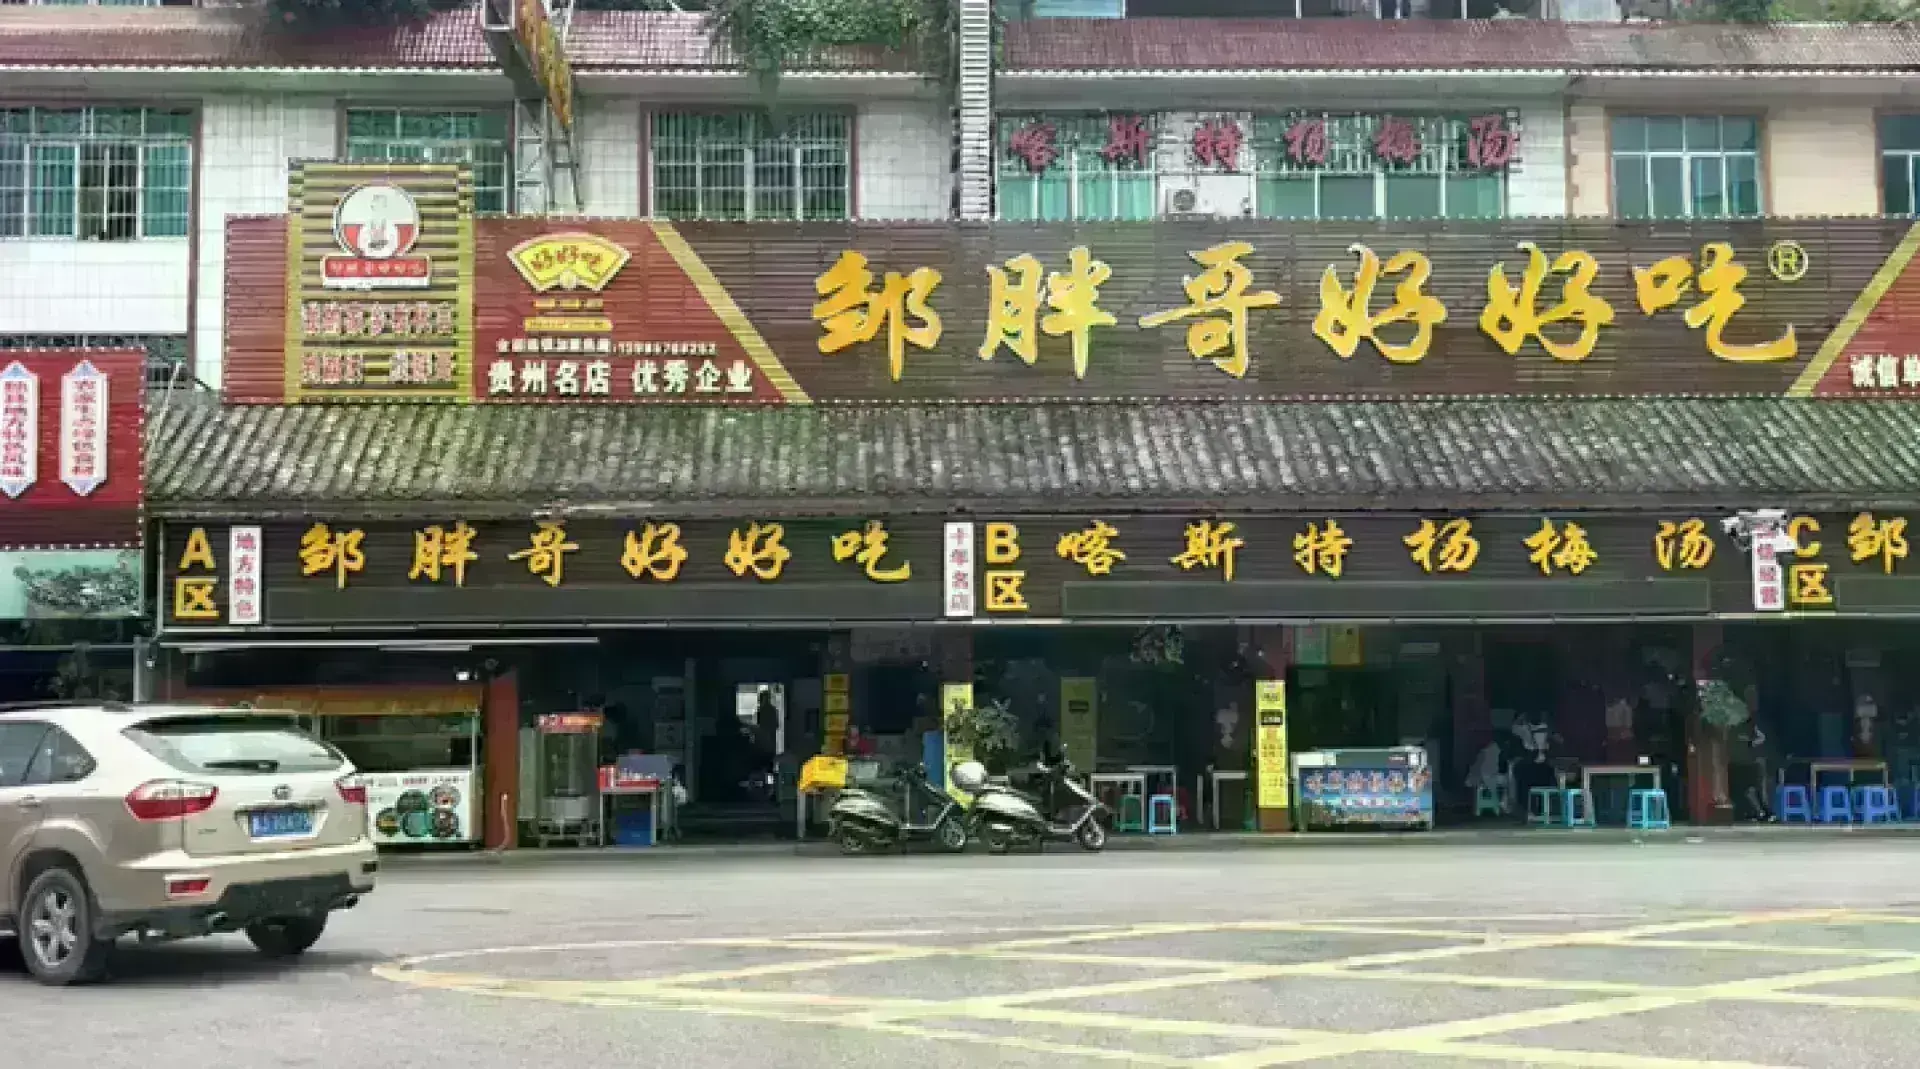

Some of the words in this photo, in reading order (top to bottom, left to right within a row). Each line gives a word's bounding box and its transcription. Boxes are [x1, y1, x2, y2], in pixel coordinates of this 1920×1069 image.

[1008, 113, 1519, 173] 喀斯特杨梅汤
[811, 240, 1798, 382] 邹胖哥好好吃
[488, 359, 611, 396] 贵州名店
[631, 359, 752, 394] 优秀企业
[172, 527, 220, 619] A区
[233, 530, 257, 619] 地方特色
[299, 521, 911, 589] 邹胖哥好好吃
[985, 522, 1030, 612] B区
[1056, 517, 1715, 581] 喀斯特杨梅汤
